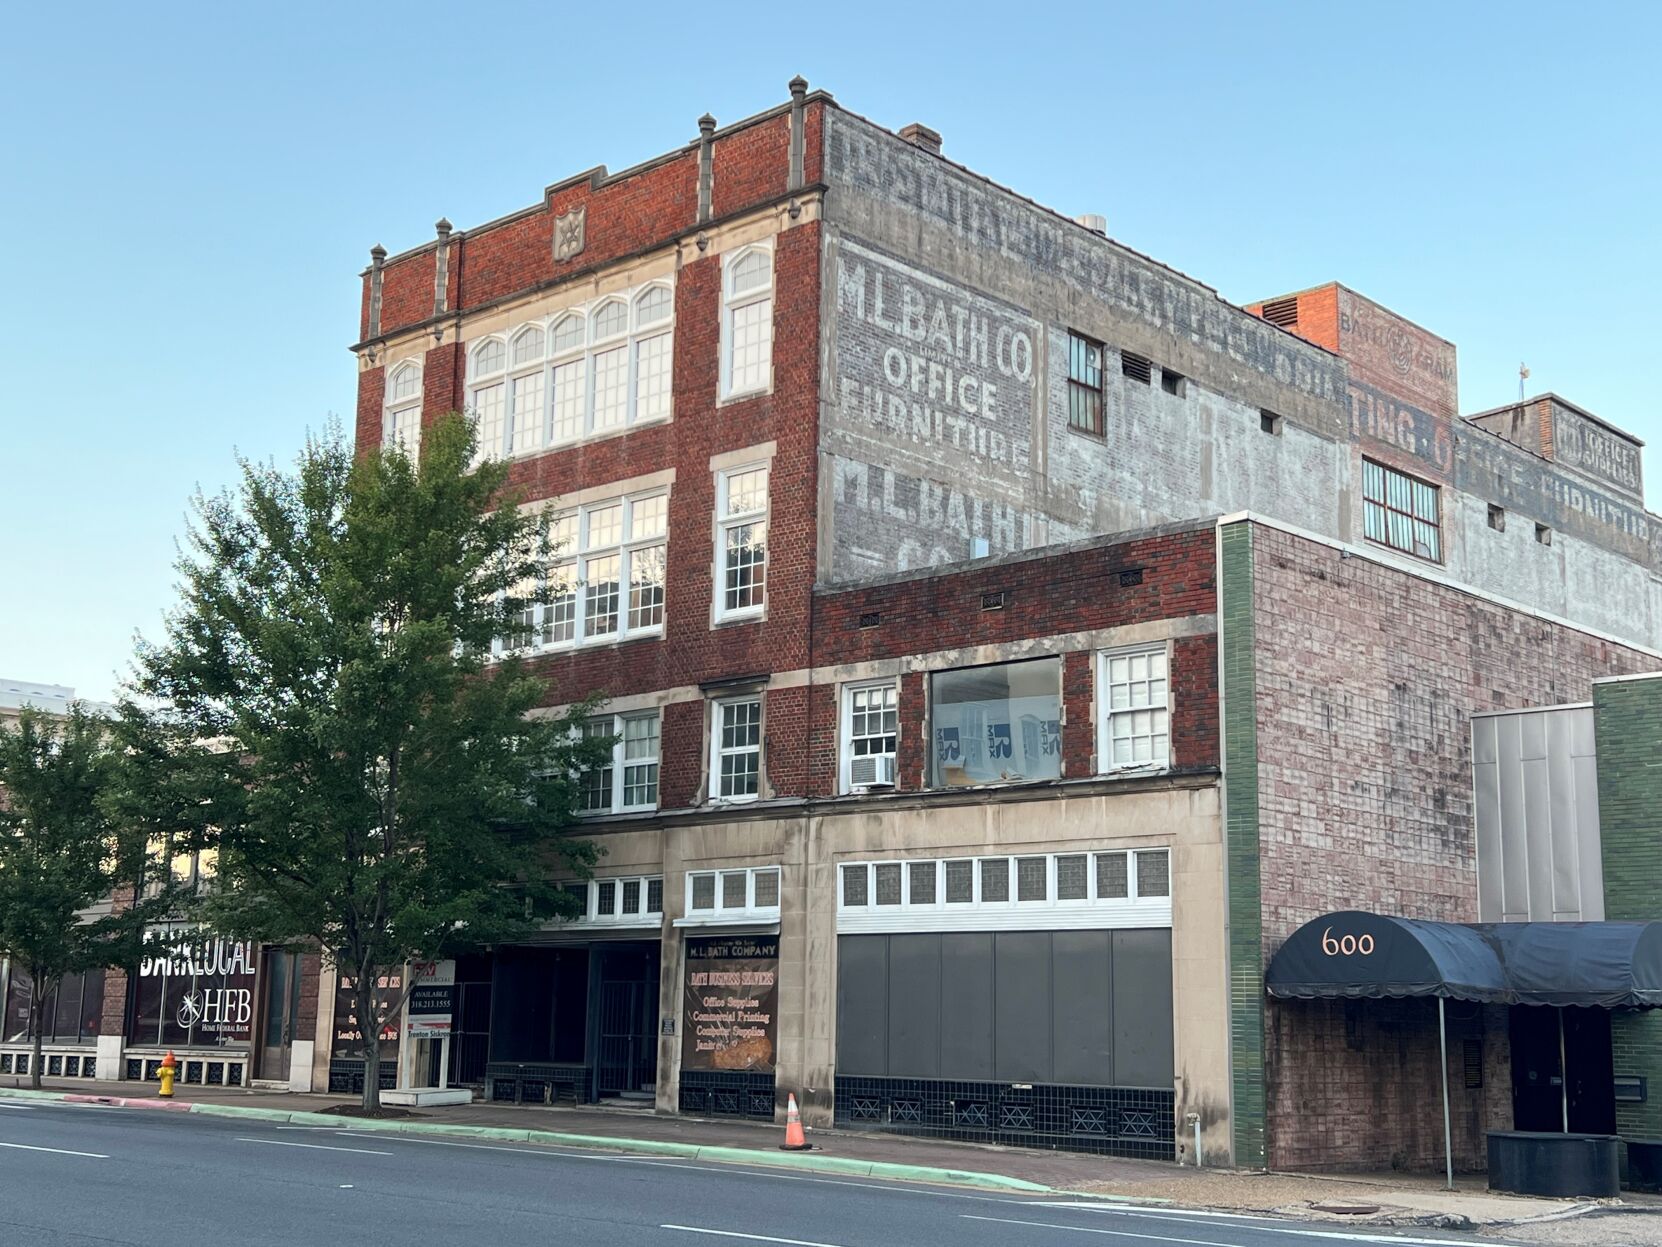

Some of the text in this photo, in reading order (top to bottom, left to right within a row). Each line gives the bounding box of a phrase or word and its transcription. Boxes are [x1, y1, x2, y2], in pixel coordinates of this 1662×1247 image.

[884, 347, 997, 421] OFFICE
[987, 724, 997, 758] MAX
[1321, 925, 1375, 957] 600
[708, 946, 729, 957] BATH
[732, 945, 776, 956] COMPANY
[415, 990, 449, 998] AVAILABLE
[202, 988, 251, 1023] HFB
[703, 996, 759, 1008] Office Supplies
[693, 1011, 770, 1024] Commercial Printing
[696, 1025, 766, 1038] Computer Supplies
